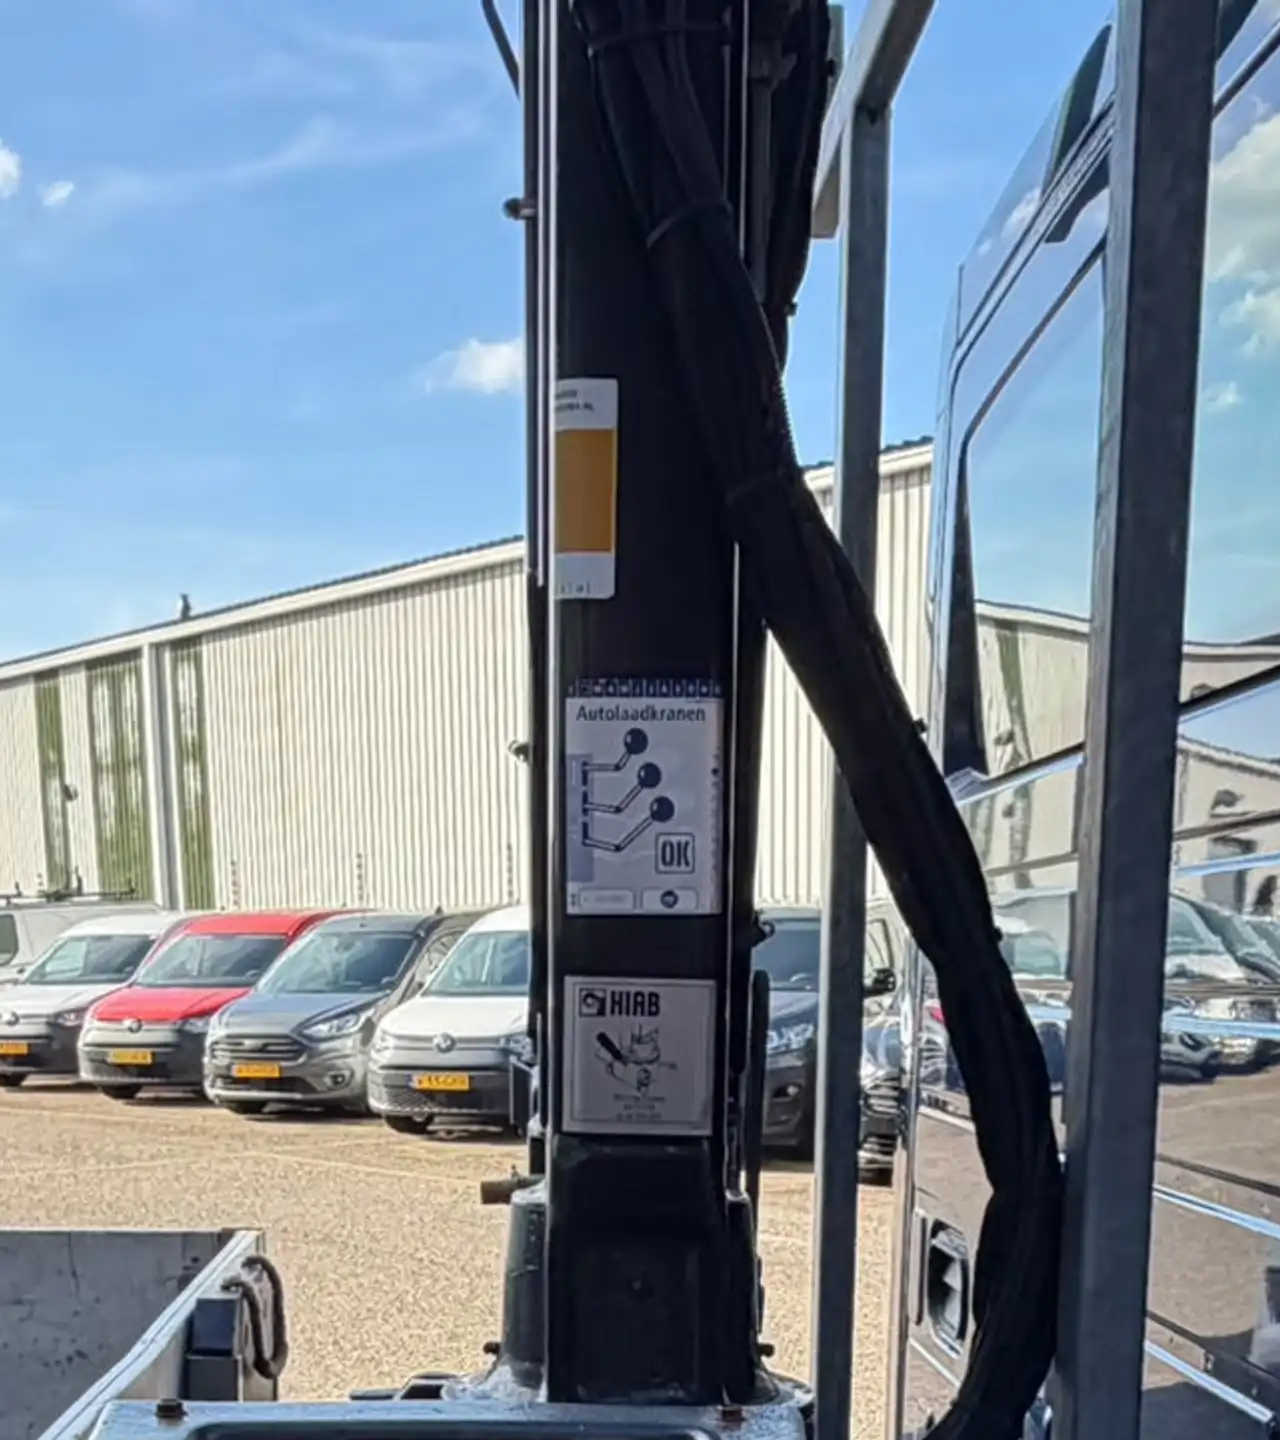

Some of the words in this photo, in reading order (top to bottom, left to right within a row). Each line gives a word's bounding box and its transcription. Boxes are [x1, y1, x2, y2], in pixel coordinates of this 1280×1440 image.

[576, 705, 706, 721] Autolaadkranen
[661, 841, 690, 868] OK
[610, 991, 660, 1017] HIAB
